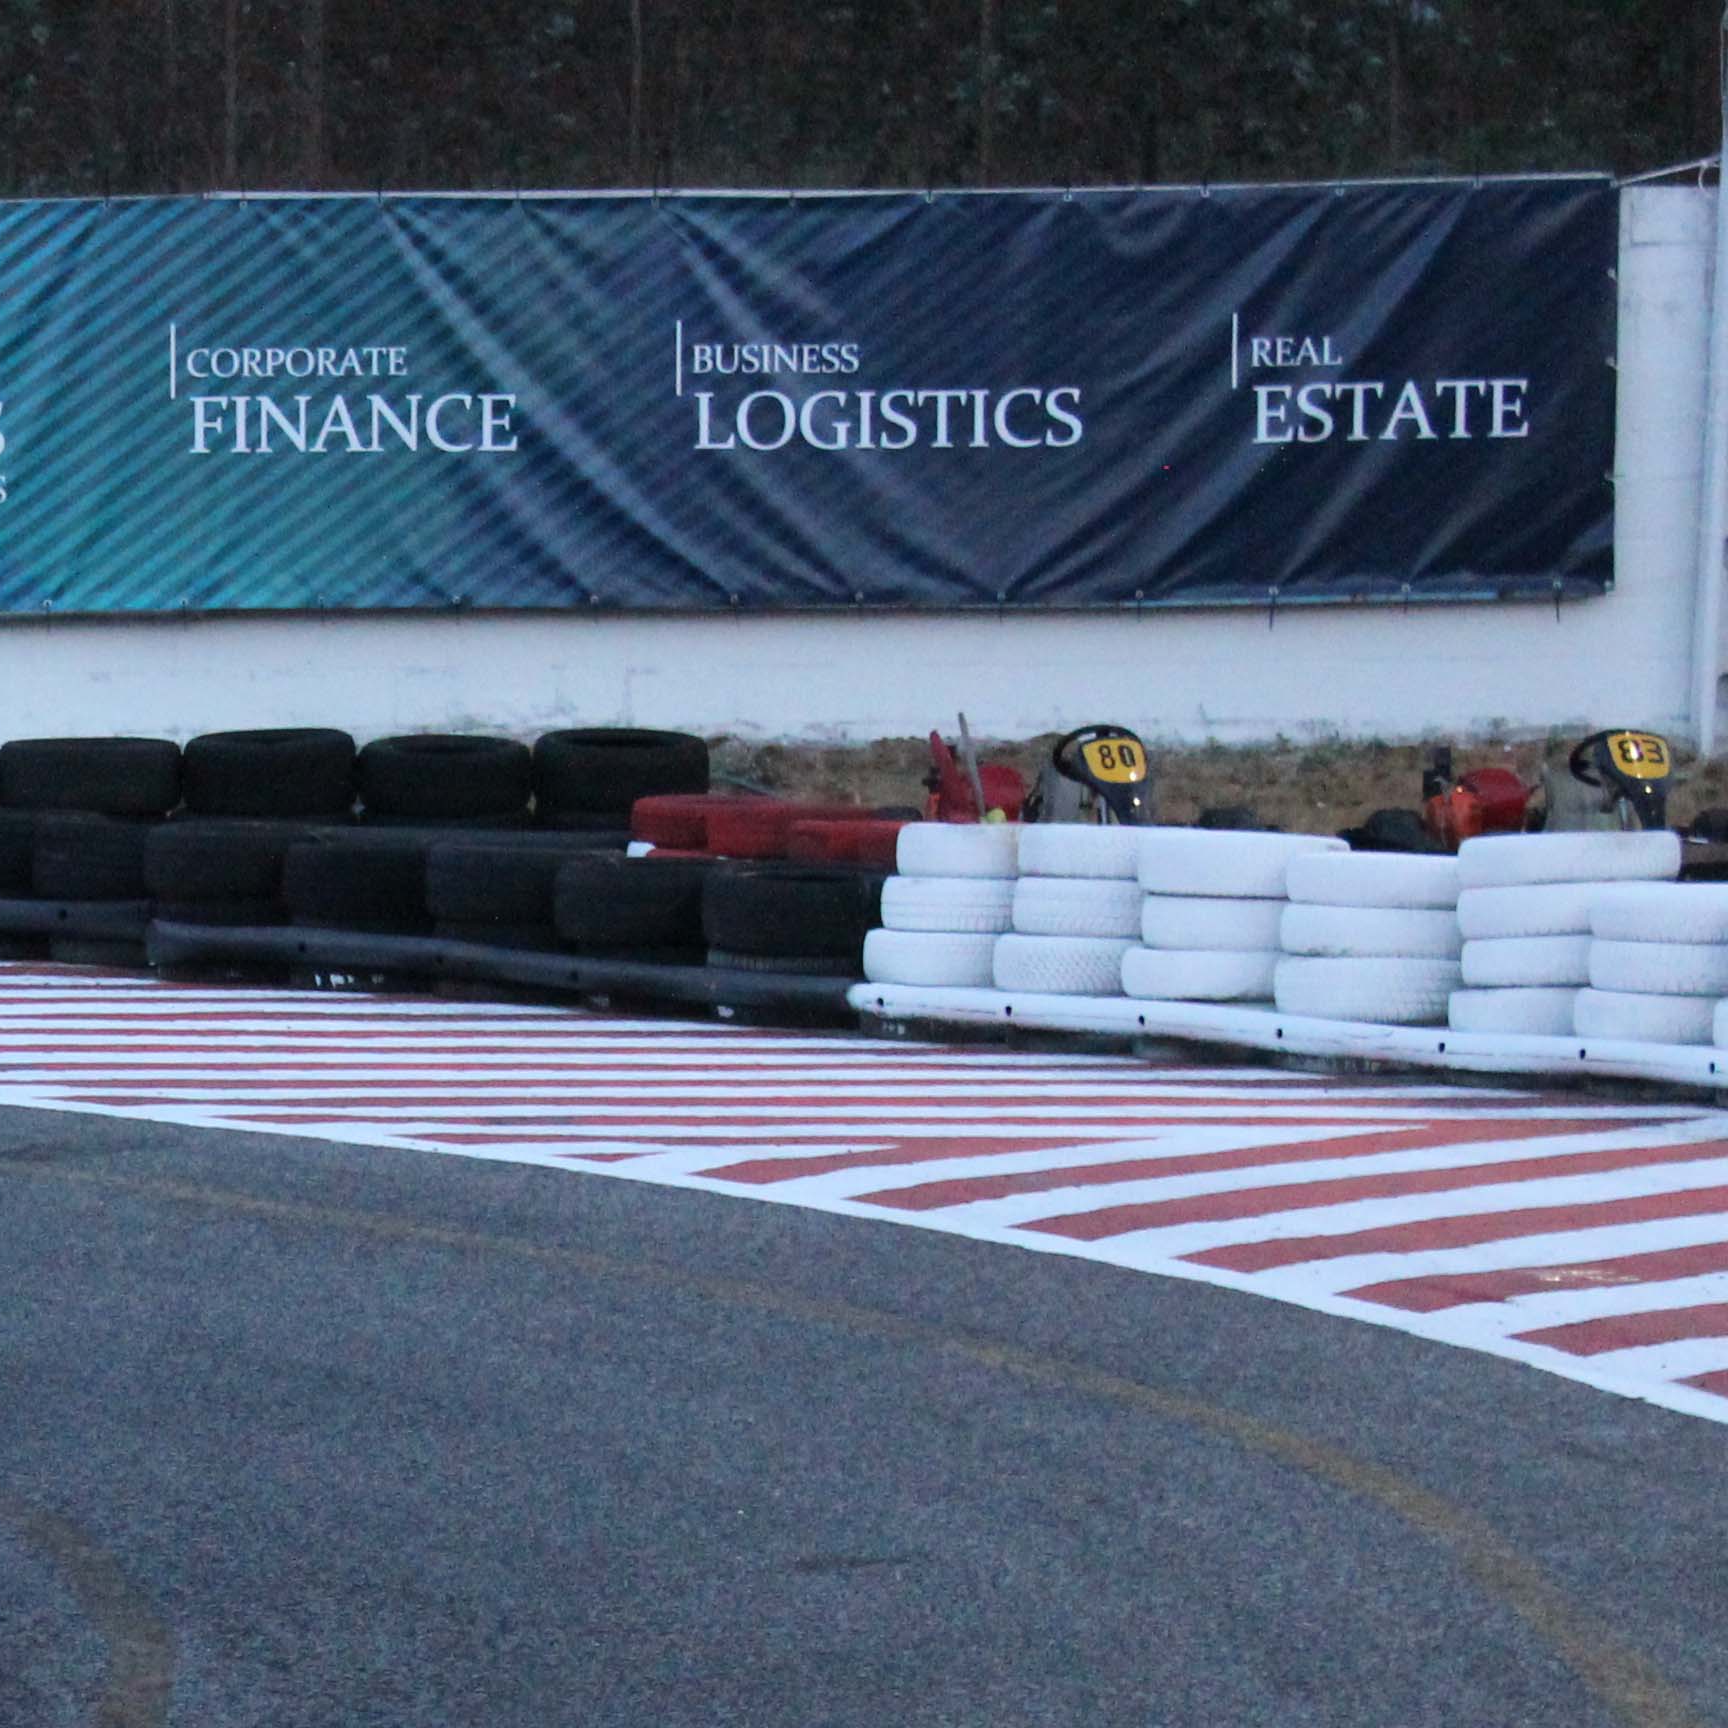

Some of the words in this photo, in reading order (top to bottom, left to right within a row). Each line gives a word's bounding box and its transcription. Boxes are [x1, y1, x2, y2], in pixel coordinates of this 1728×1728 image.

[185, 346, 409, 380] CORPORATE
[691, 342, 861, 375] BUSINESS
[1250, 336, 1343, 368] REAL
[188, 392, 520, 455] FINANCE
[693, 385, 1084, 454] LOGISTICS
[1251, 377, 1531, 445] ESTATE
[1099, 744, 1136, 770] 80
